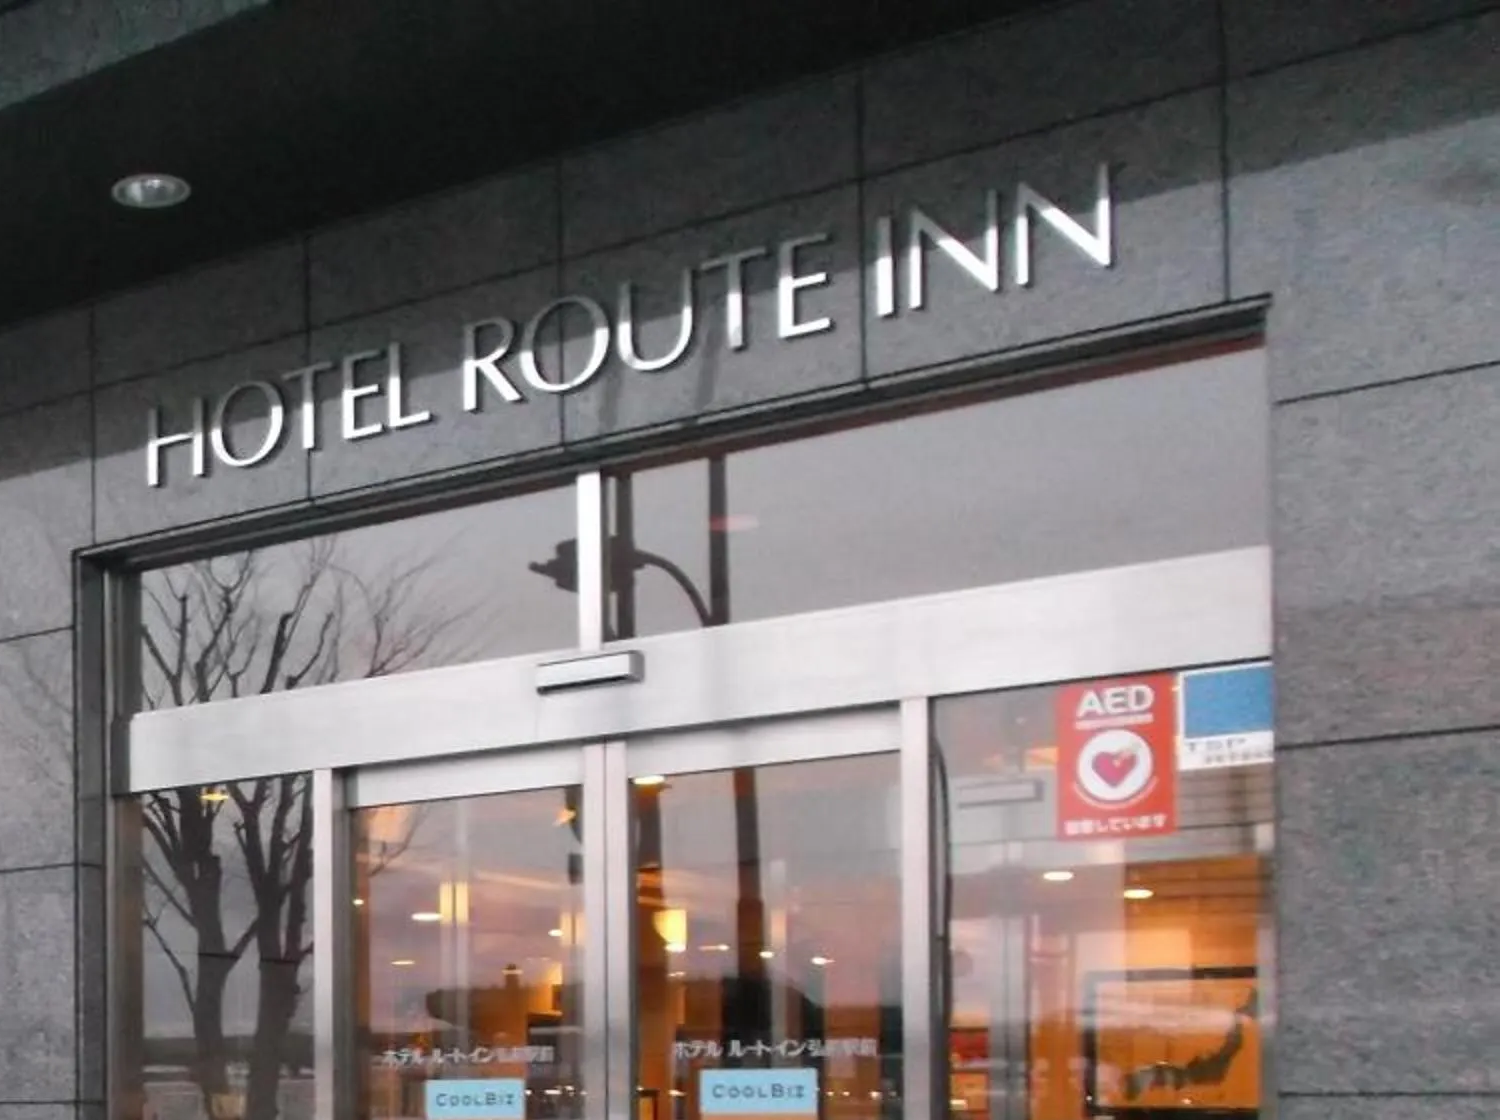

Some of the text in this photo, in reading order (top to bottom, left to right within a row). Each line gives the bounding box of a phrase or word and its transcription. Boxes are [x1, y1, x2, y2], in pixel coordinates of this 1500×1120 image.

[145, 161, 1114, 485] HOTEL ROUTE INN
[1075, 684, 1155, 718] AED
